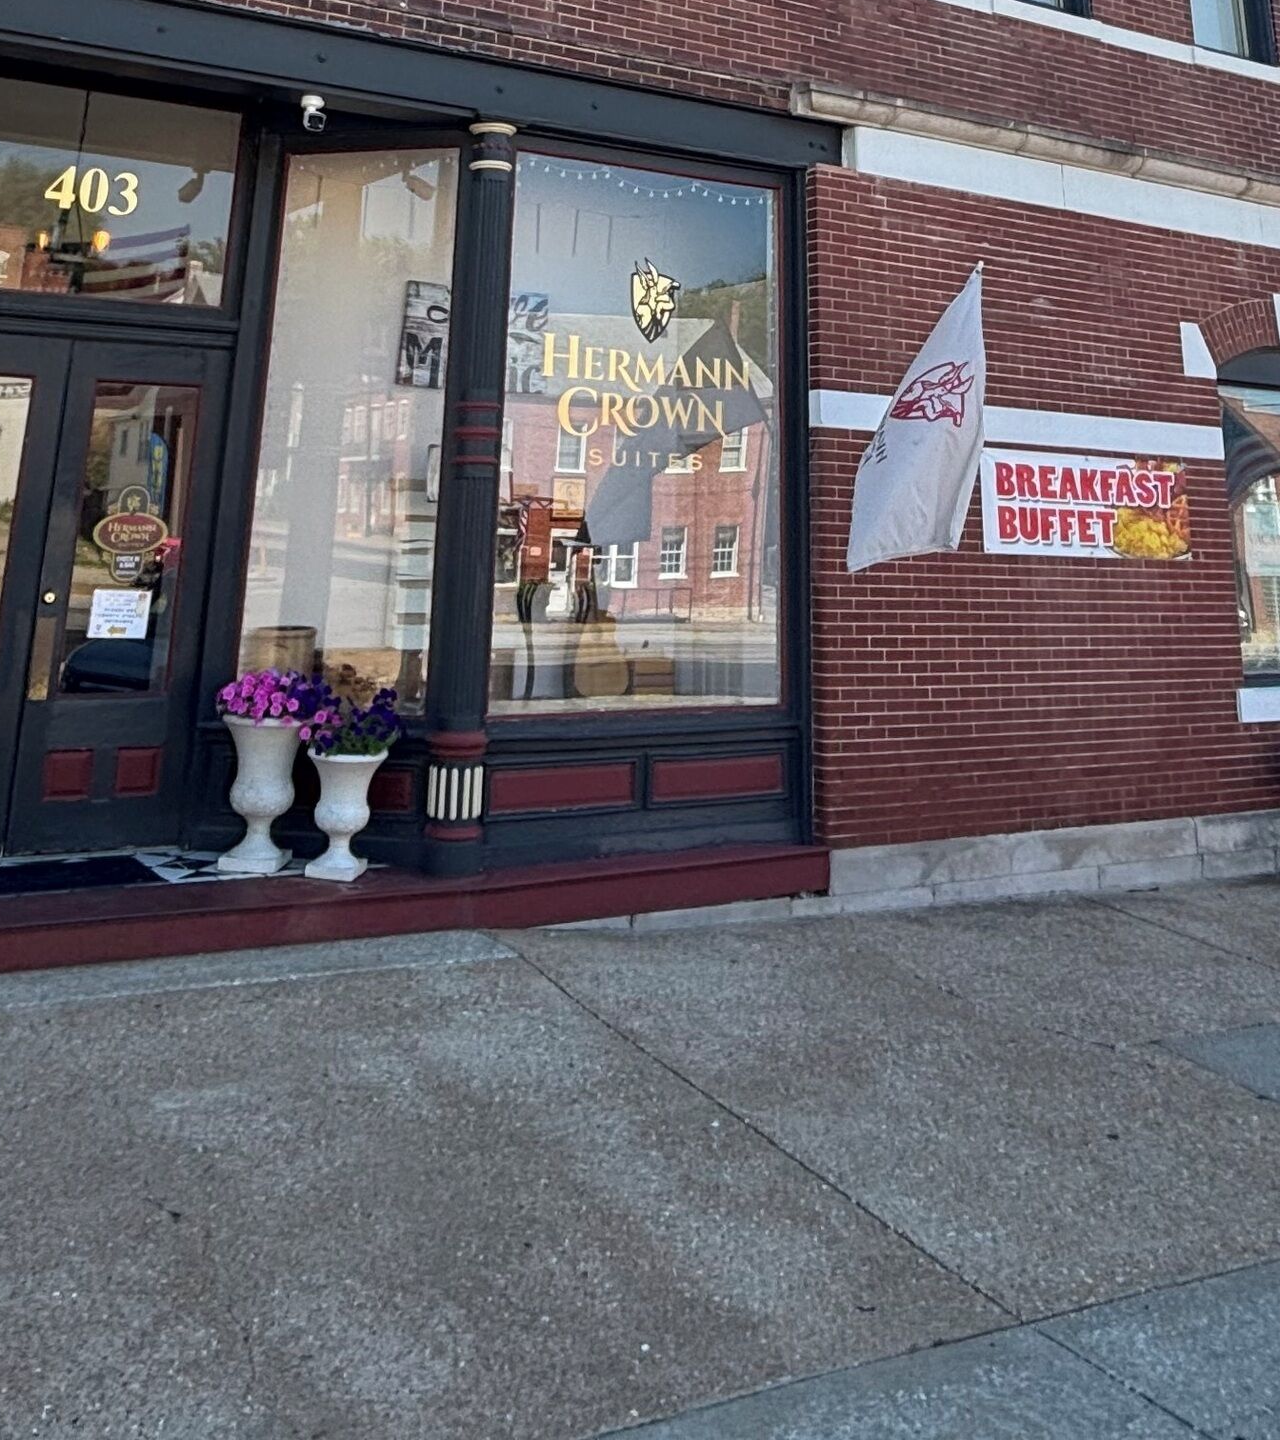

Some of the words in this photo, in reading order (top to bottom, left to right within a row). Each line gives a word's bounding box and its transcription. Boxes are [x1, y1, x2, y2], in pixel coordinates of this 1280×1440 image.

[44, 165, 139, 216] 403
[541, 332, 750, 392] HERMANN
[557, 386, 730, 440] CROWN
[588, 447, 704, 471] SUITES
[994, 461, 1174, 508] BREAKFAST
[108, 522, 157, 533] HERMANN
[111, 532, 150, 542] CROWN
[998, 505, 1119, 547] BUFFET
